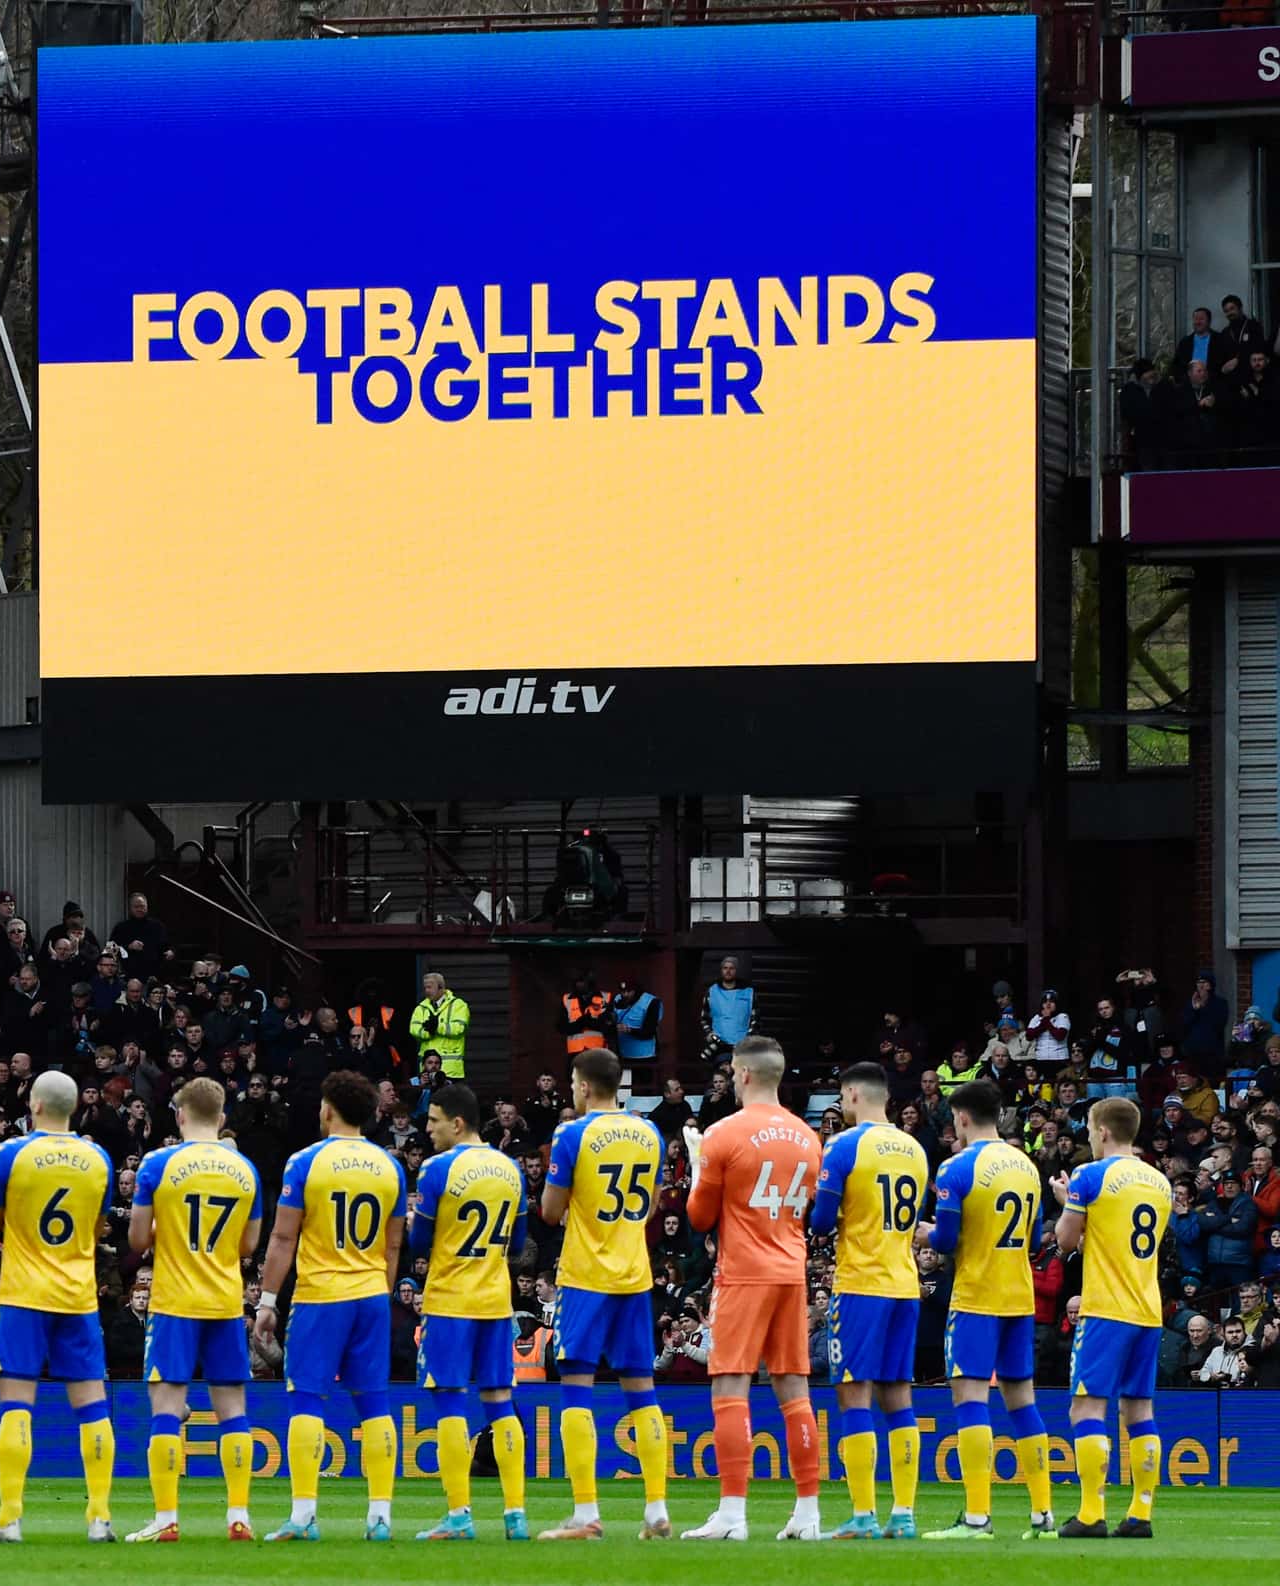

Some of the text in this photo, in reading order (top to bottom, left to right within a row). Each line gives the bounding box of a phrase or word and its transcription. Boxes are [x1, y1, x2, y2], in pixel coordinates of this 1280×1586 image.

[1258, 46, 1280, 82] S
[132, 271, 937, 363] FOOTBALL STANDS
[298, 344, 764, 424] TOGETHER
[444, 677, 616, 716] adi.tv
[34, 1151, 90, 1172] ROMEU
[332, 1157, 382, 1176] ADAMS
[590, 1128, 654, 1154] BEDNAREK
[750, 1126, 810, 1150] FORSTER
[875, 1141, 914, 1159] BROJA
[170, 1159, 251, 1192] ARMSTRONG
[596, 1163, 652, 1223] 35
[749, 1160, 809, 1220] 44
[876, 1173, 918, 1232] 18
[39, 1186, 74, 1246] 6
[183, 1193, 240, 1253] 17
[330, 1191, 381, 1250] 10
[455, 1199, 511, 1257] 24
[995, 1190, 1035, 1248] 21
[1130, 1203, 1158, 1259] 8
